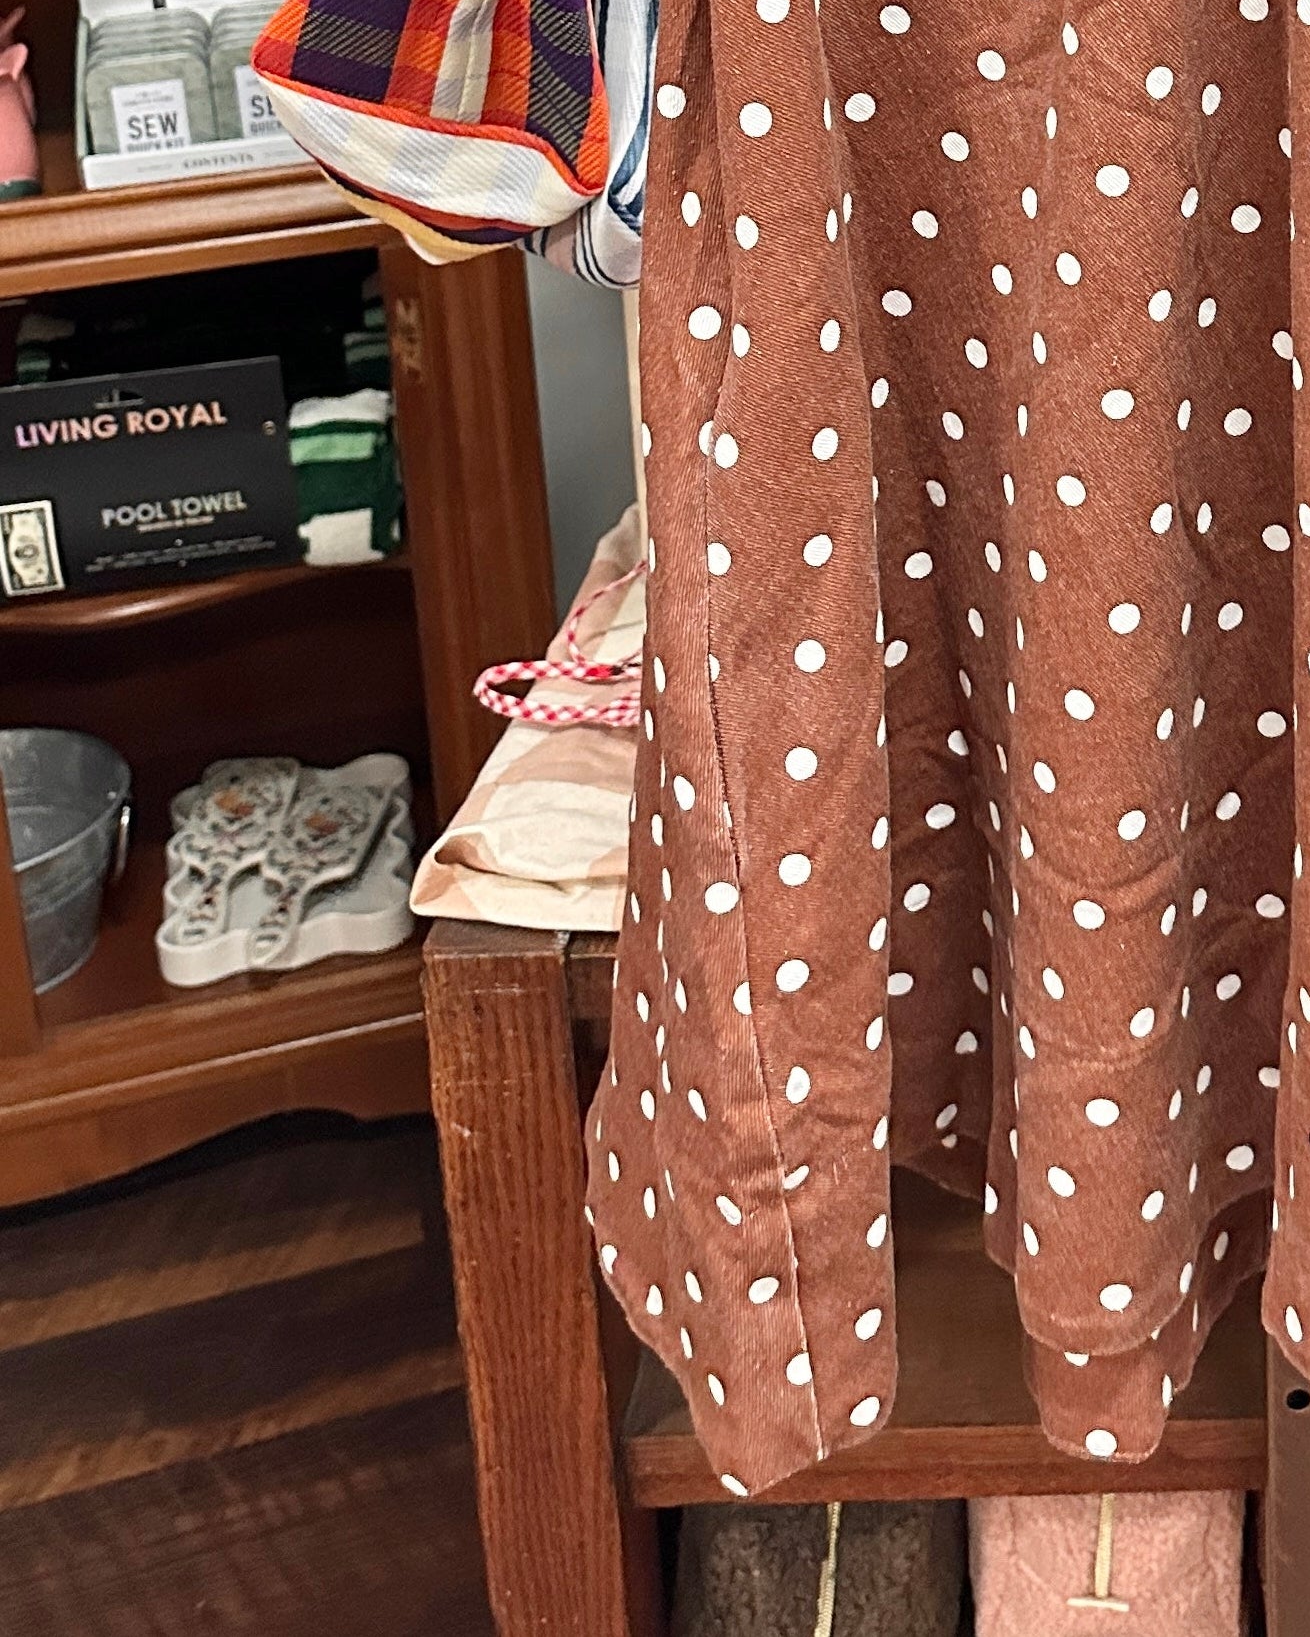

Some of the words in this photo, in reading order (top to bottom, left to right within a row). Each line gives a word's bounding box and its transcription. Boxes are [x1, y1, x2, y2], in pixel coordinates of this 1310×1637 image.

[127, 112, 178, 140] SEW
[15, 414, 119, 450] LIVING
[125, 401, 228, 435] ROYAL
[101, 500, 168, 530] POOL
[170, 490, 248, 518] TOWEL
